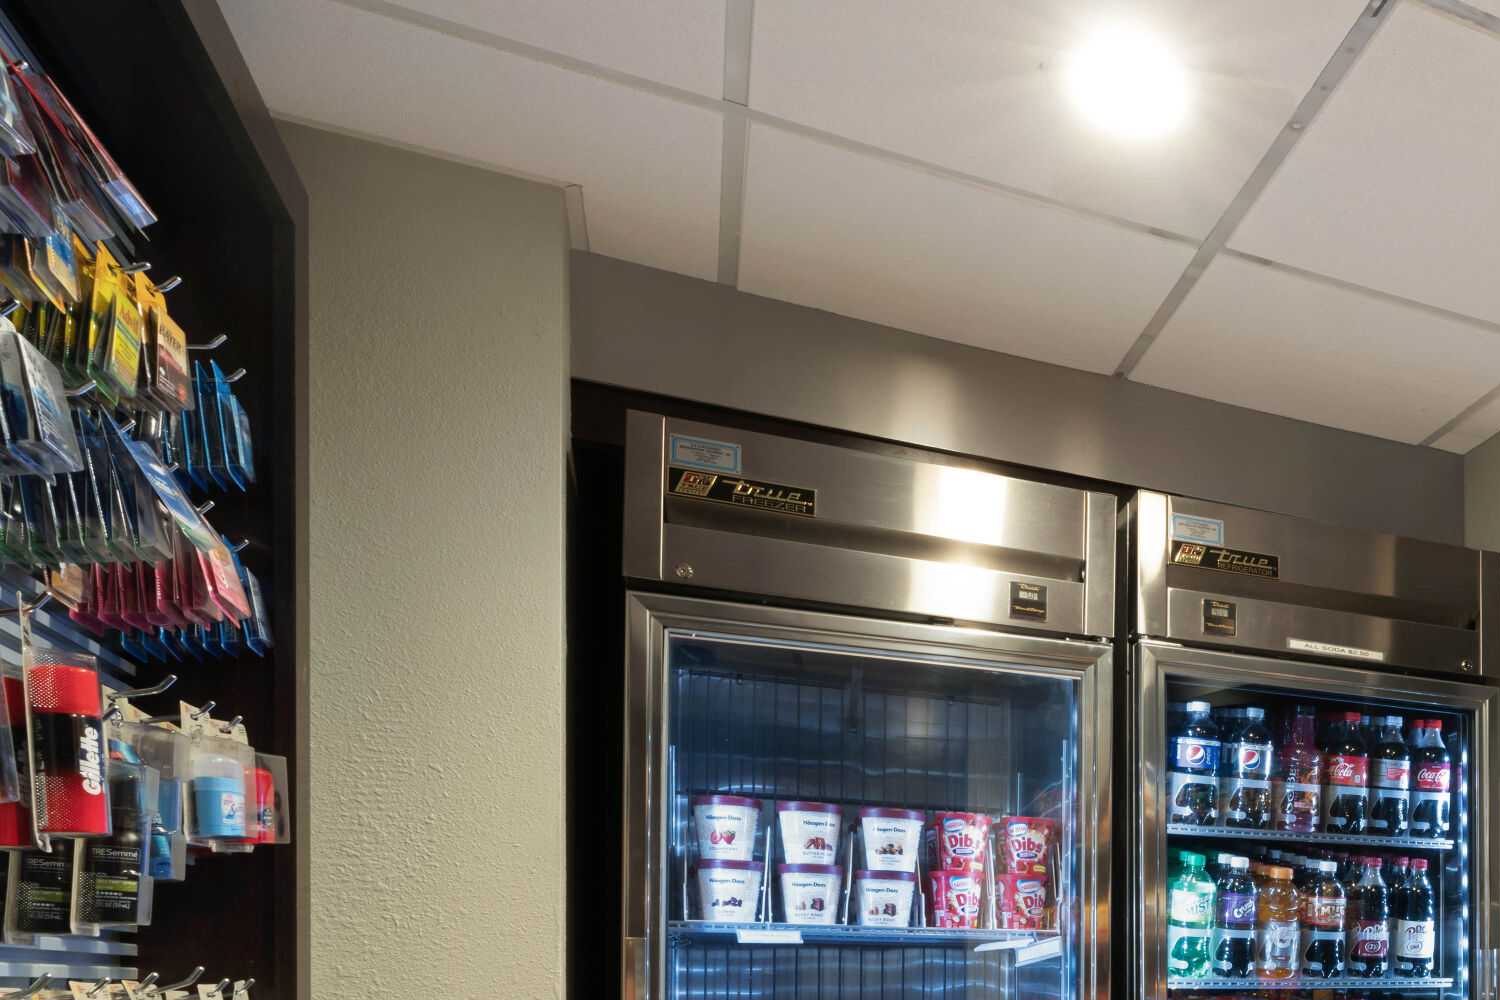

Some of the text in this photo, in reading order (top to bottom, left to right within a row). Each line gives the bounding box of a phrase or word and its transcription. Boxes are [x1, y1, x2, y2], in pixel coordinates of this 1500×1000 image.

[732, 494, 807, 513] FREEZER
[1218, 561, 1273, 576] REFRIGERATOR
[1321, 645, 1346, 654] SODA
[79, 725, 103, 795] Gillette
[1011, 836, 1043, 853] Dibs
